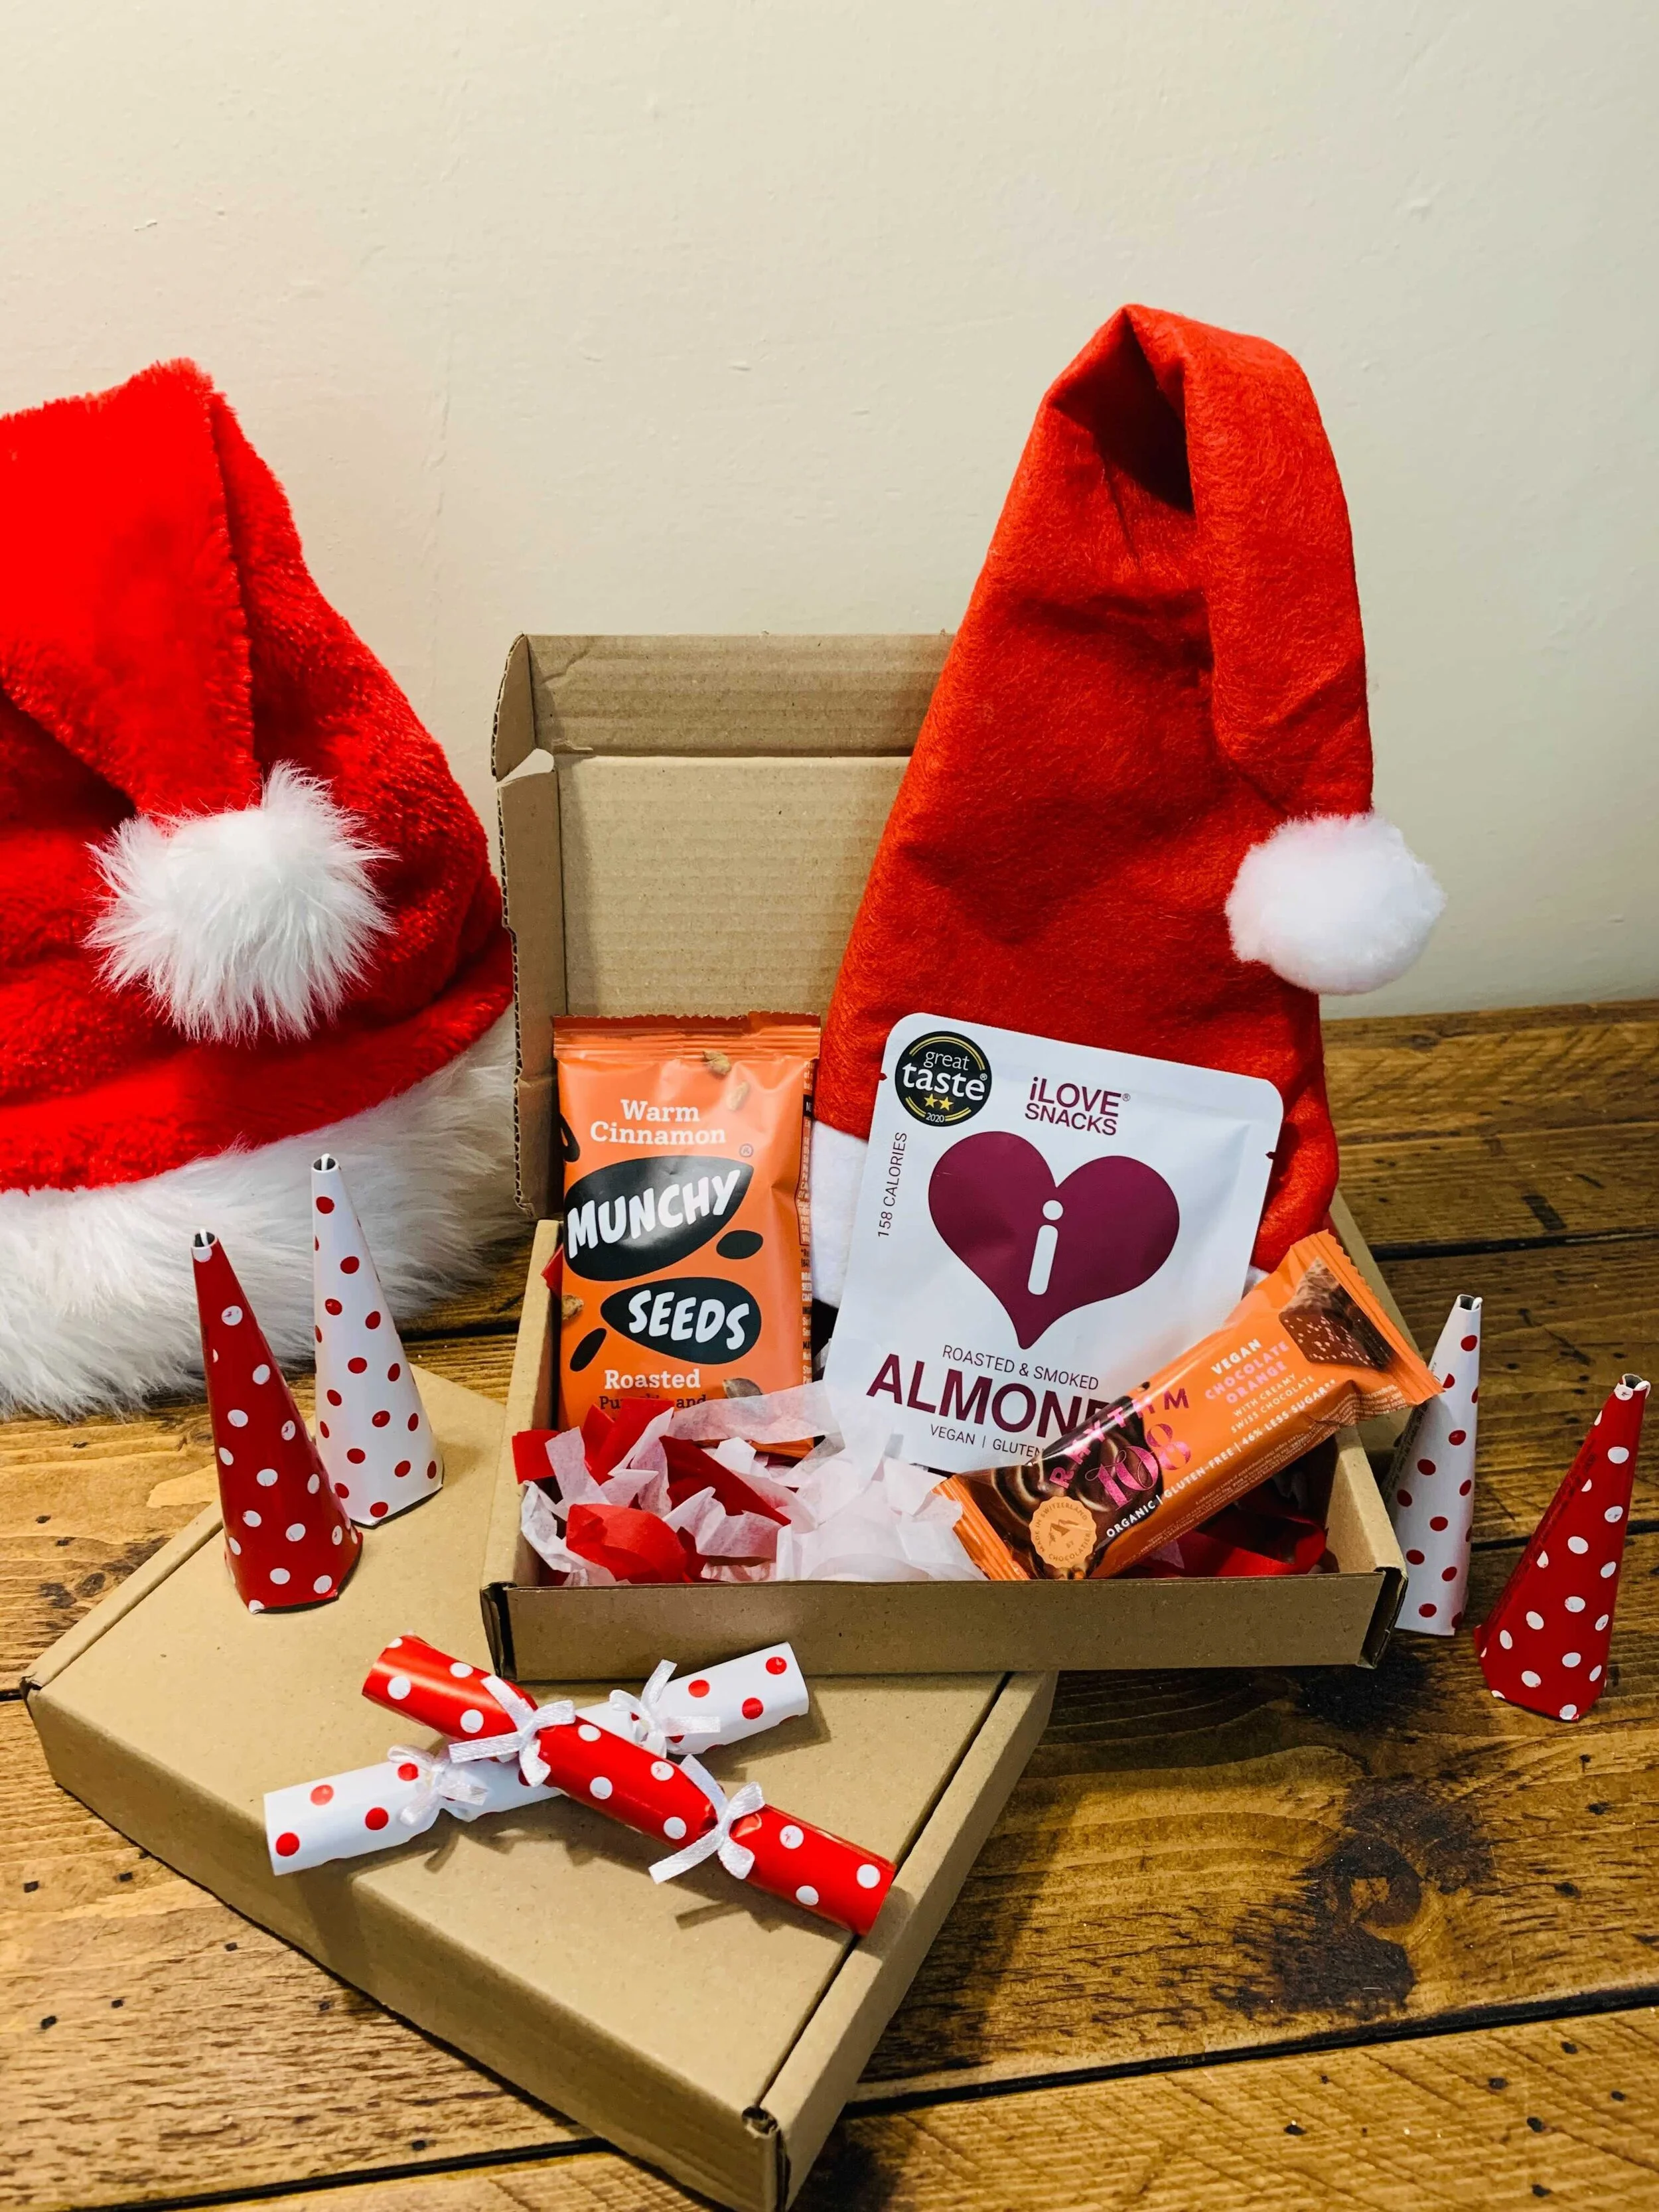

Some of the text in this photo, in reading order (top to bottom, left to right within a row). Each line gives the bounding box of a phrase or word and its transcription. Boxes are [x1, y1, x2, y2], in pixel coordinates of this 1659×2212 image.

[923, 1051, 970, 1071] great
[620, 1099, 700, 1122] Warm
[926, 1112, 945, 1123] 2020
[1025, 1102, 1118, 1136] SNACKS
[590, 1120, 726, 1145] Cinnamon
[878, 1132, 907, 1237] 158 CALORIES
[567, 1169, 741, 1259] MUNCHY
[628, 1290, 750, 1350] SEEDS
[942, 1345, 1099, 1390] ROASTED & SMOKED
[1205, 1341, 1290, 1400] CHOCOLATE
[1211, 1339, 1262, 1374] VEGAN
[605, 1368, 701, 1389] Roasted
[1226, 1361, 1287, 1404] ORANGE
[1234, 1373, 1296, 1417] WITH CREAMY
[1231, 1412, 1259, 1434] SWISS
[1260, 1375, 1315, 1414] CHOCOLATE
[930, 1424, 975, 1445] VEGAN
[1085, 1424, 1191, 1511] 108
[1106, 1502, 1156, 1538] ORGANIC
[1164, 1447, 1234, 1499] GLUTEN-FREE
[1242, 1428, 1263, 1445] 46%
[1264, 1411, 1289, 1431] LESS
